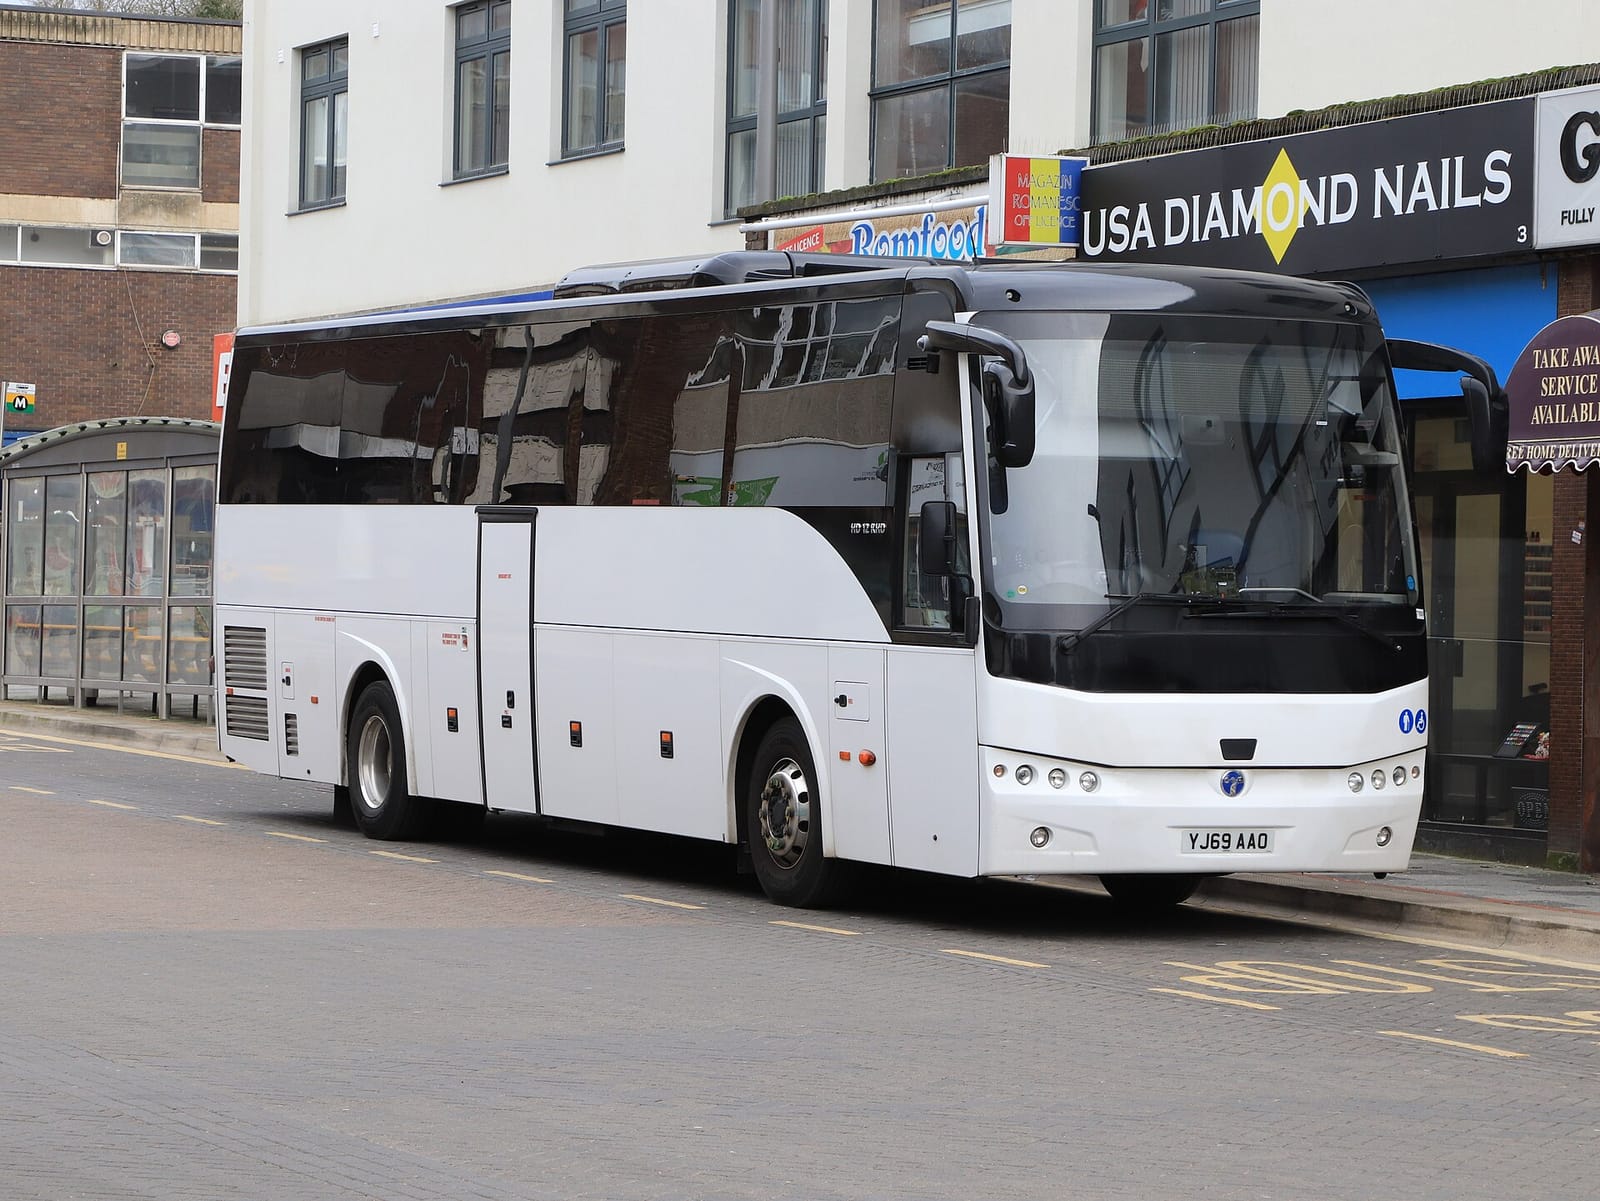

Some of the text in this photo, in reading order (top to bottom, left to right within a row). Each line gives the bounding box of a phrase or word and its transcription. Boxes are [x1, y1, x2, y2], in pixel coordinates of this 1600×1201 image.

[1017, 172, 1073, 190] MAGAZIN
[1012, 193, 1081, 212] ROMANESC
[1083, 149, 1512, 257] USA DIAMOND NAILS
[1014, 214, 1076, 229] OFF LICENCE
[1560, 207, 1596, 226] FULLY
[851, 206, 985, 260] Romfood
[1516, 225, 1528, 243] 3
[1532, 345, 1600, 370] TAKE AWA
[1541, 373, 1598, 397] SERVICE
[14, 396, 27, 409] M
[1526, 444, 1557, 460] HOME
[850, 522, 862, 534] HD
[1189, 832, 1232, 850] YJ69
